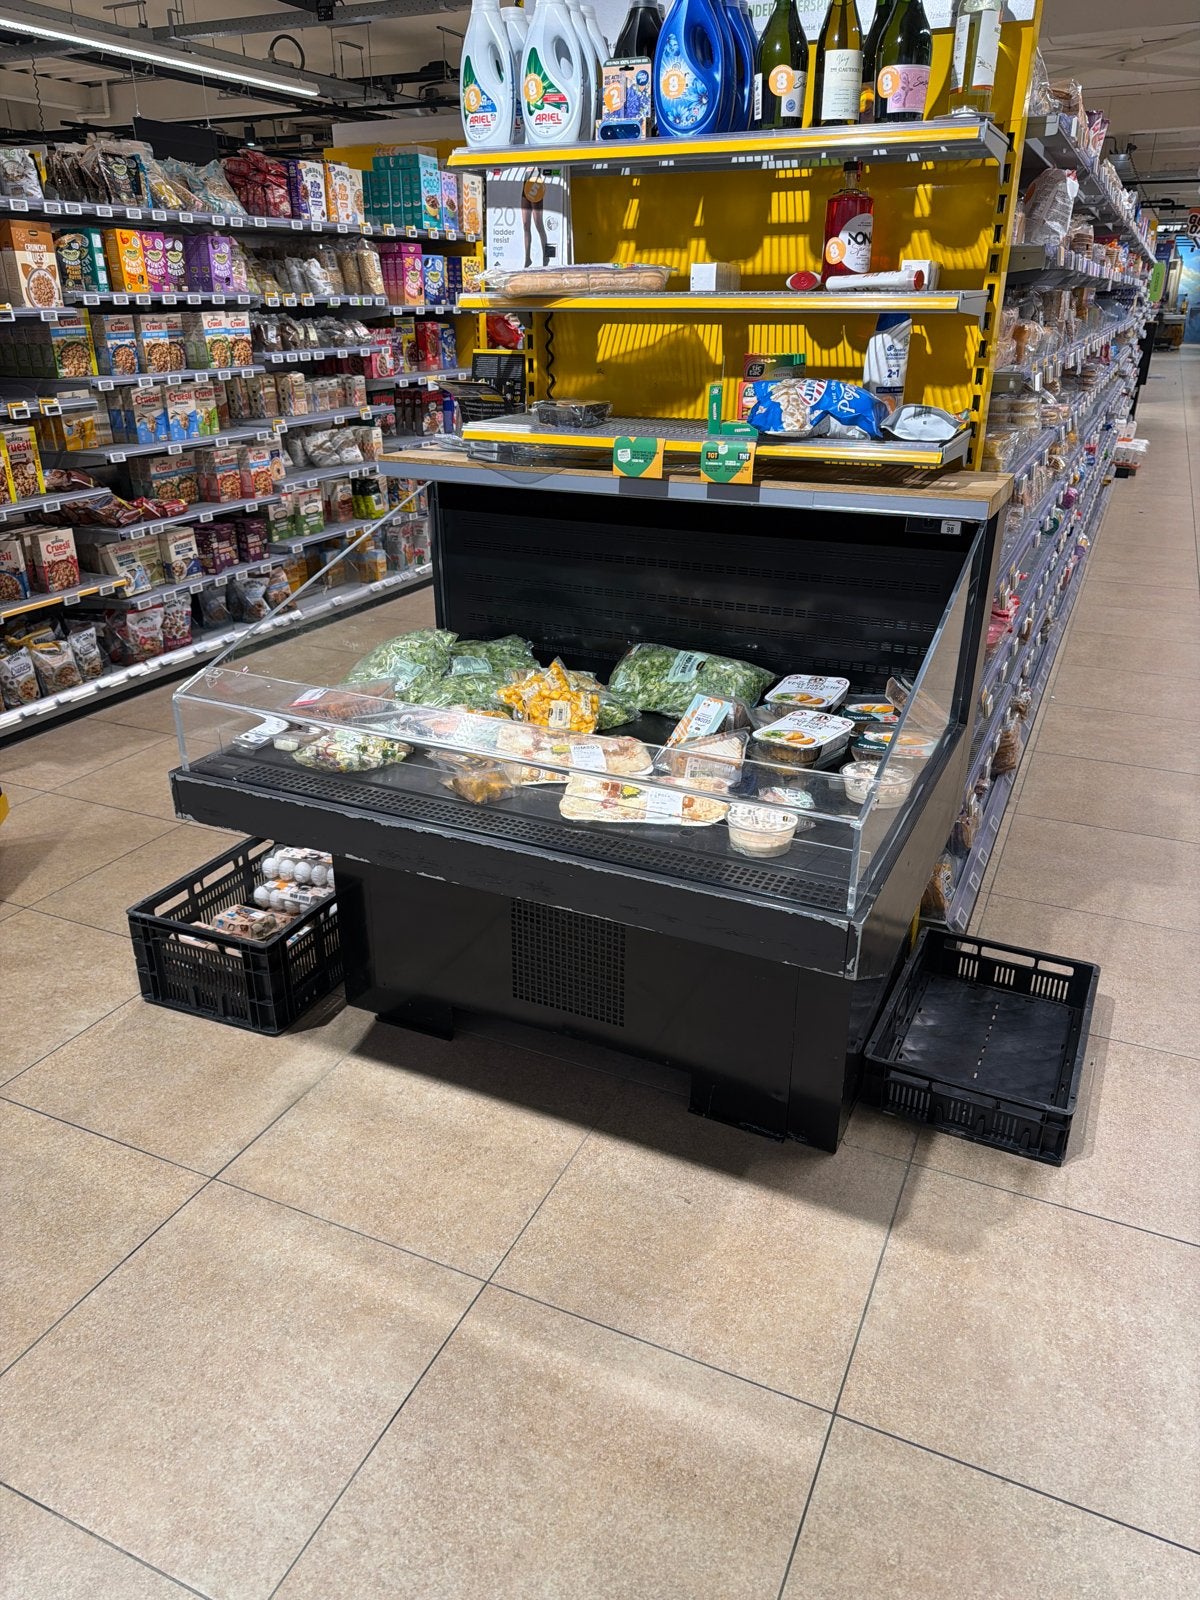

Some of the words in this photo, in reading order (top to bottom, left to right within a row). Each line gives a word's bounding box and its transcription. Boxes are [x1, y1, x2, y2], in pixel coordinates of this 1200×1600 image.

[470, 115, 491, 124] ARIEL
[535, 112, 562, 123] ARIEL
[493, 207, 516, 227] 20
[493, 228, 515, 236] ladder
[110, 323, 129, 332] Cruesli
[207, 319, 223, 328] Cruesli
[230, 319, 246, 328] Cruesli
[135, 393, 160, 405] Cruesli
[169, 392, 193, 402] Cruesli
[194, 388, 213, 400] Cruesli
[46, 540, 71, 554] Cruesli
